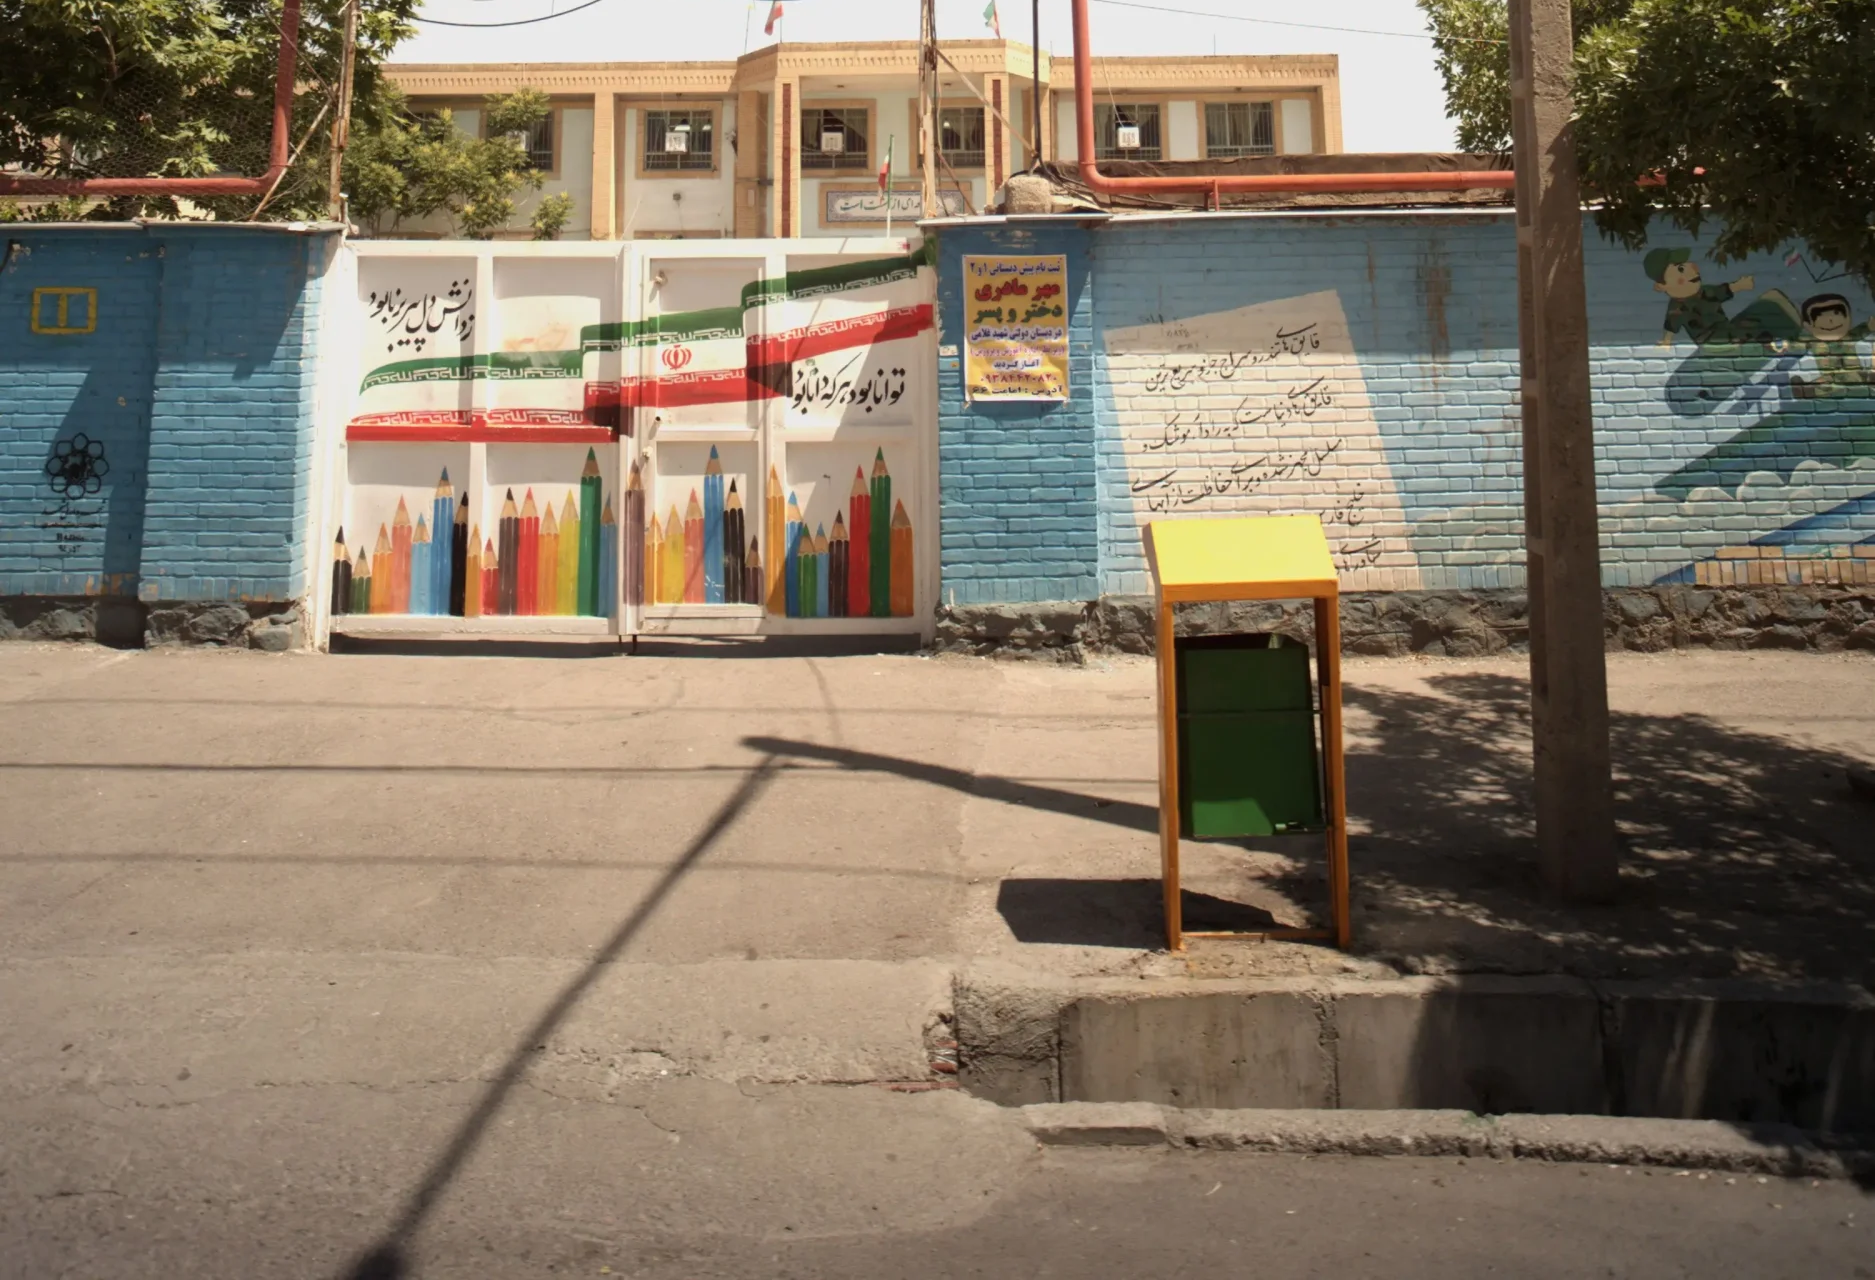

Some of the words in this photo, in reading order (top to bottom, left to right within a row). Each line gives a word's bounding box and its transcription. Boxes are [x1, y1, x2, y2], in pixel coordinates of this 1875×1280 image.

[369, 290, 389, 325] بود
[973, 305, 1003, 324] پسر
[1006, 307, 1017, 323] و
[1021, 301, 1063, 323] دختر
[846, 379, 873, 414] بود
[873, 367, 906, 407] توانا
[1319, 499, 1344, 526] فار
